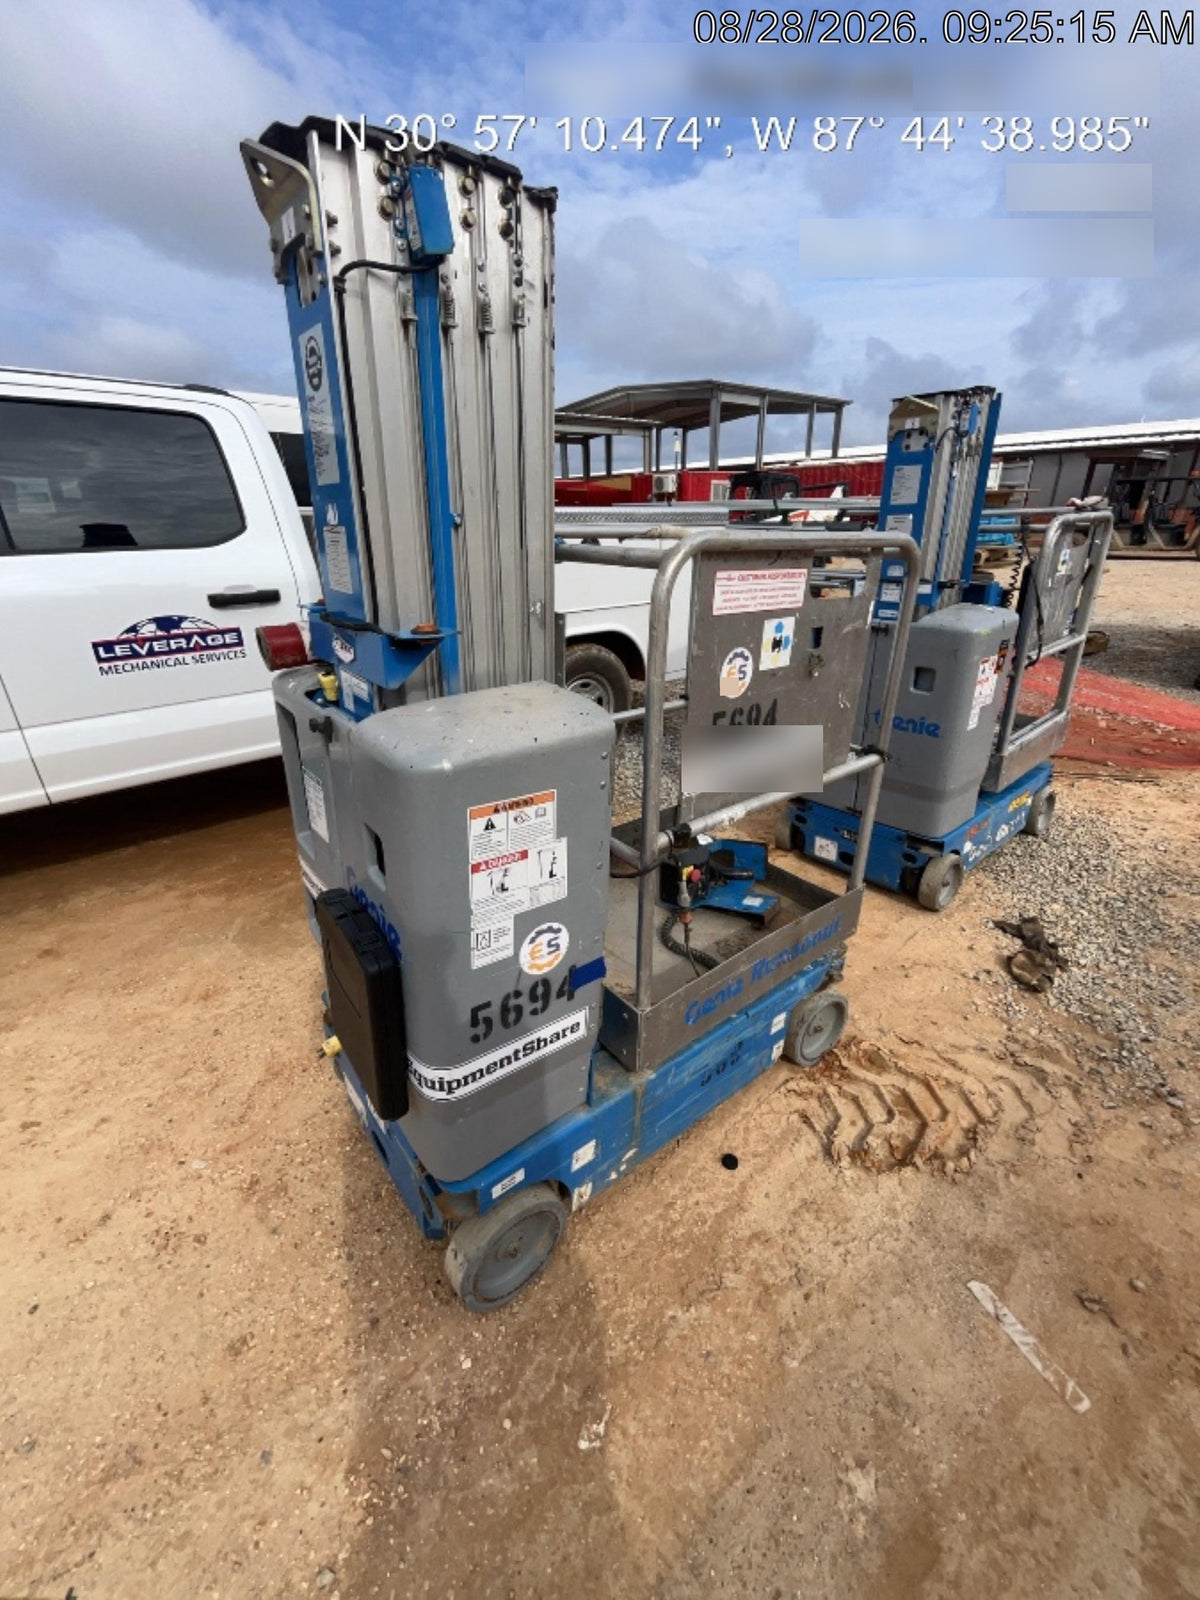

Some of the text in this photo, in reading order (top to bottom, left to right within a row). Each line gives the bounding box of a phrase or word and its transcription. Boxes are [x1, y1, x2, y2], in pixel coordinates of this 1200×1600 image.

[97, 632, 240, 659] LEVERAGE
[99, 648, 247, 677] MECHANICAL SERVICES
[470, 964, 578, 1044] 5694
